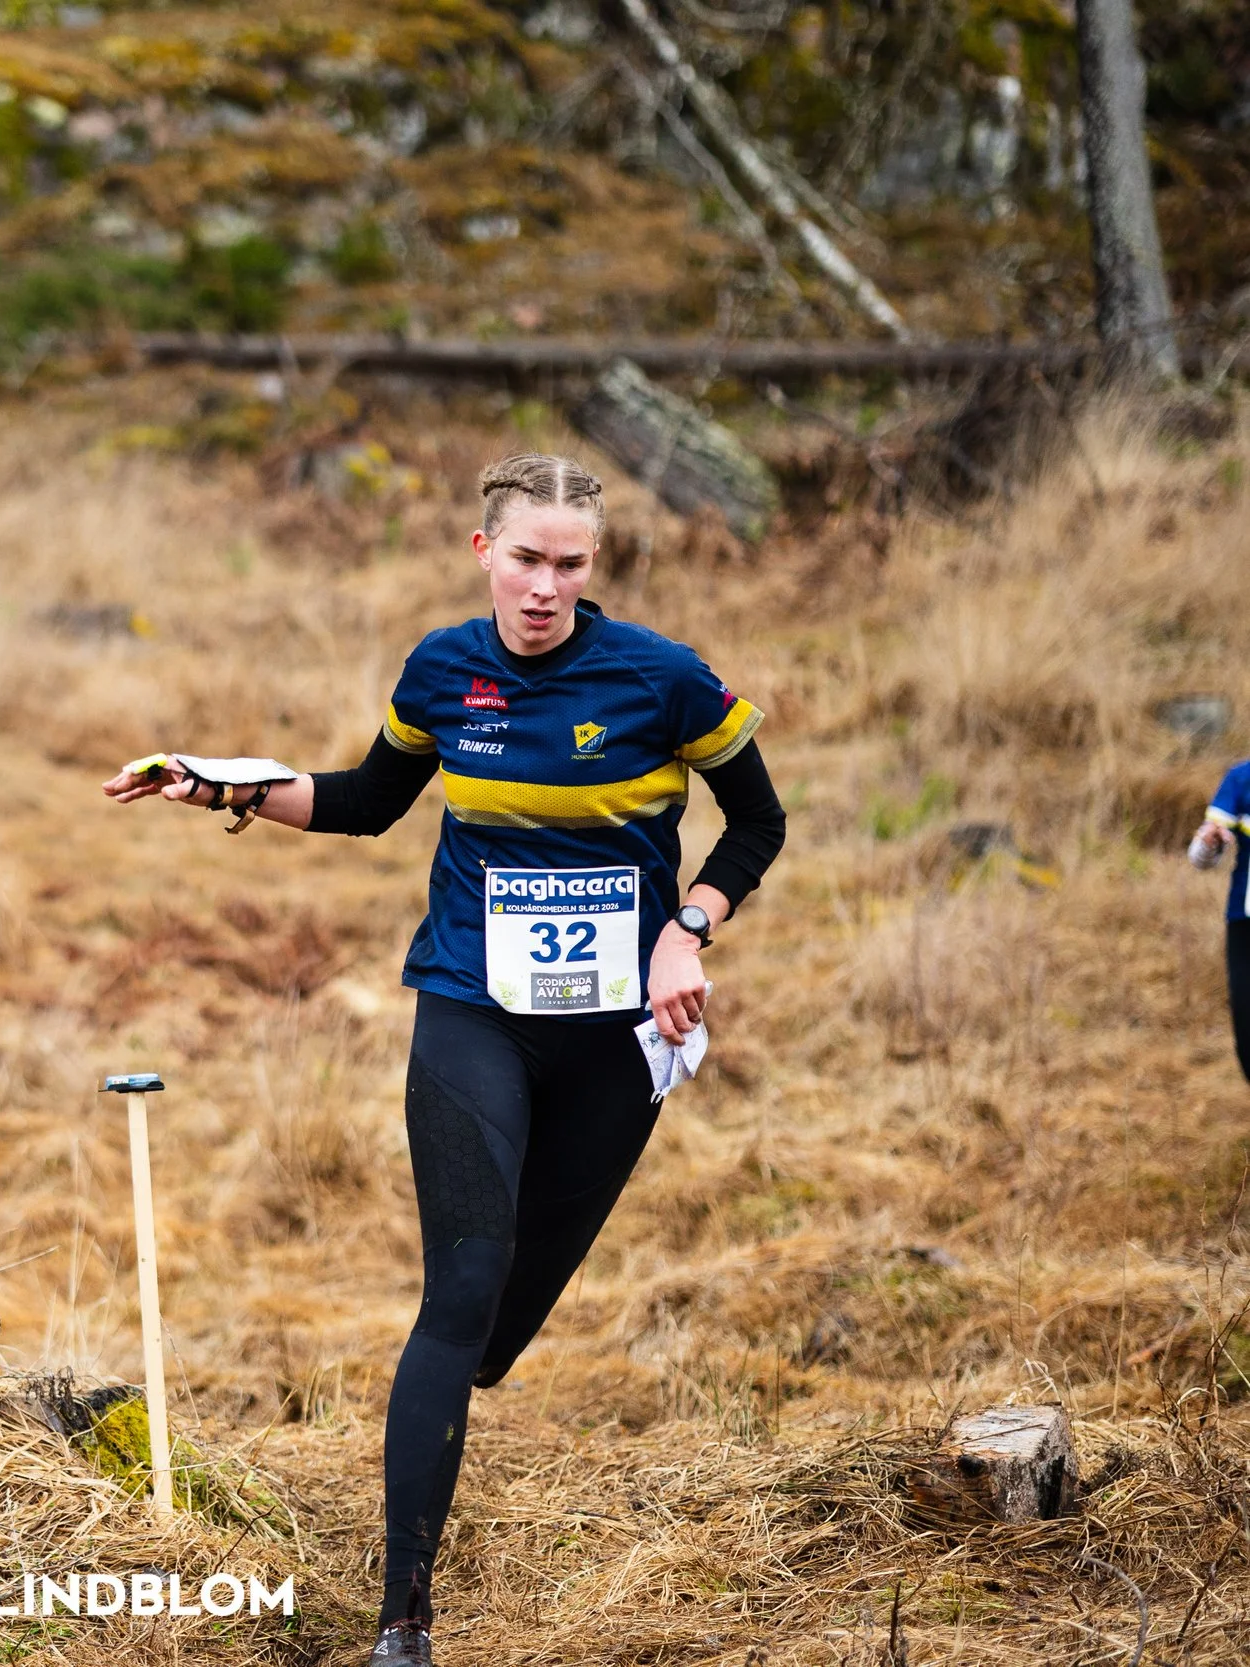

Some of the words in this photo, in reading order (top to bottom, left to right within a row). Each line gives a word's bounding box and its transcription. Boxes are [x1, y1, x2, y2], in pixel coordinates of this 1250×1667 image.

[471, 676, 499, 695] ICA
[465, 697, 506, 707] KVANTUM
[579, 729, 590, 739] IK
[457, 738, 505, 755] TRIMTEX
[490, 874, 634, 901] bagheera
[506, 903, 577, 913] KOLMÅRDSMEDELN
[578, 904, 588, 912] SL
[588, 904, 600, 912] #2
[601, 903, 619, 911] 2026
[529, 921, 598, 964] 32
[536, 976, 593, 987] GODKÄNDA
